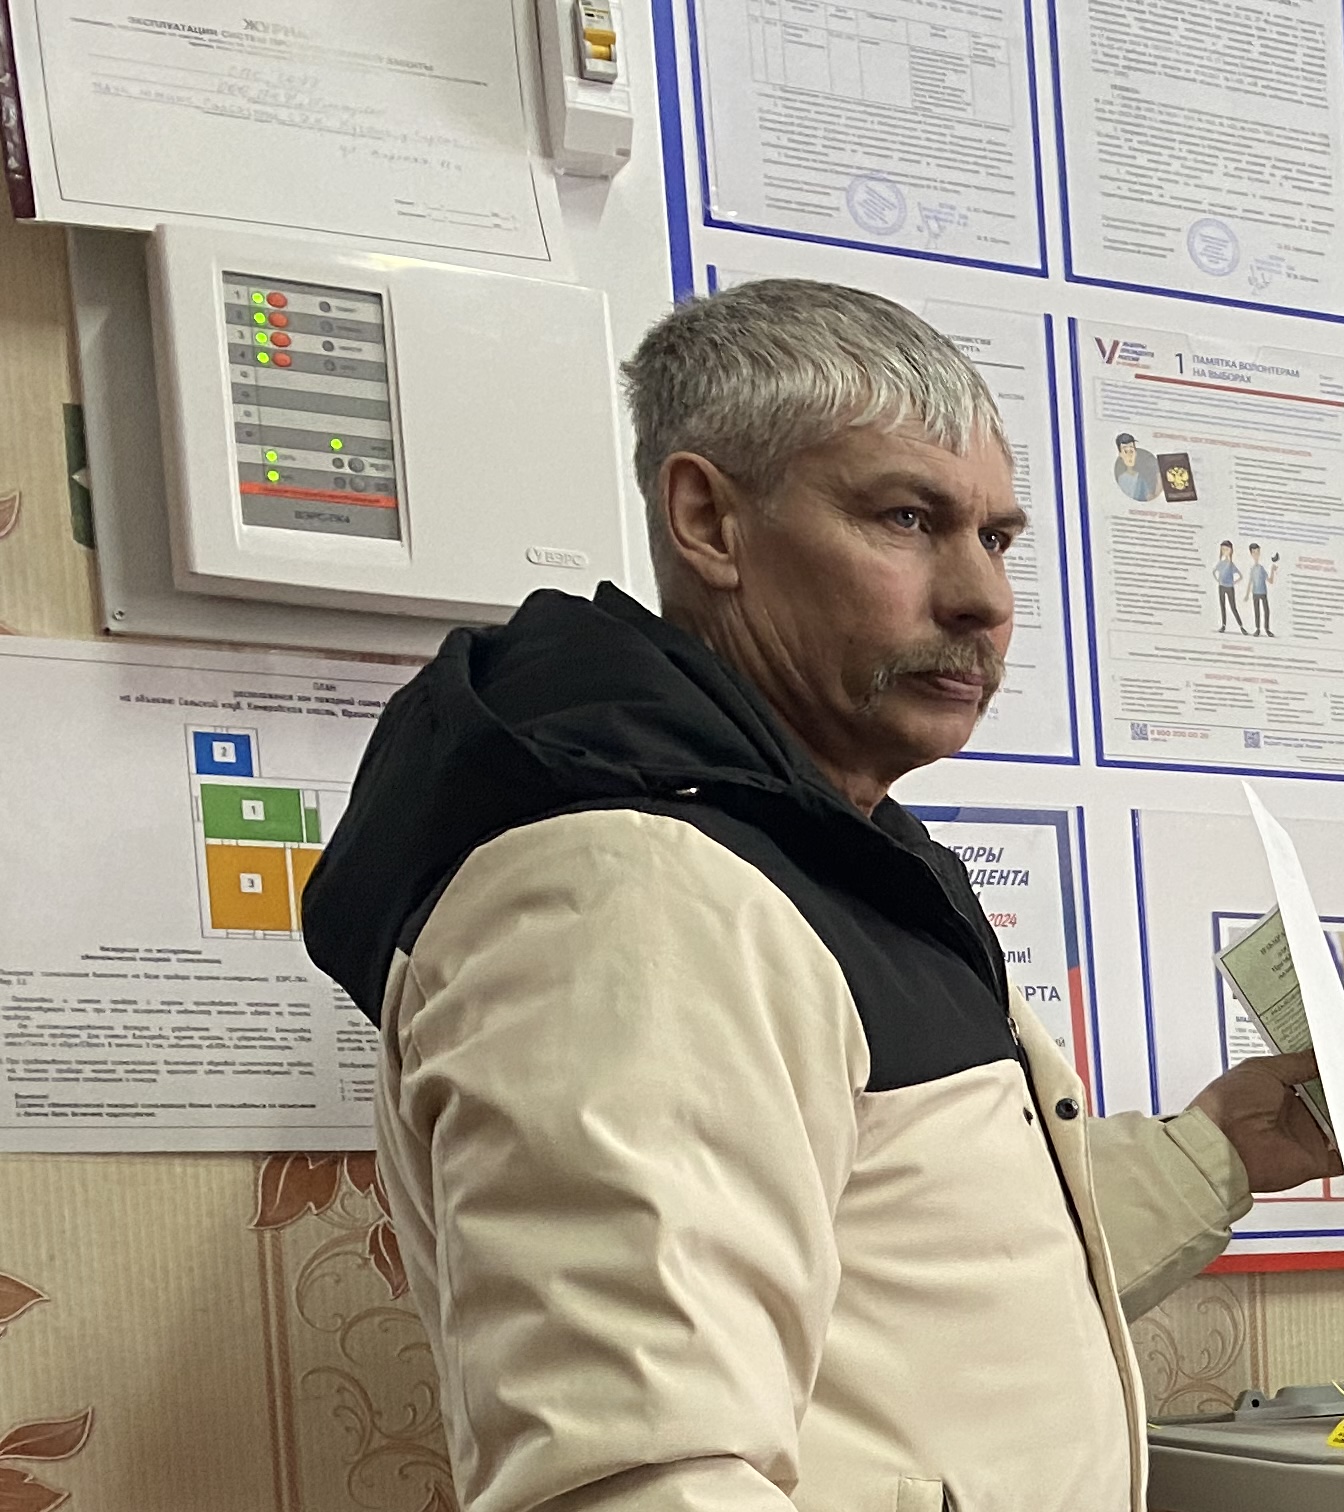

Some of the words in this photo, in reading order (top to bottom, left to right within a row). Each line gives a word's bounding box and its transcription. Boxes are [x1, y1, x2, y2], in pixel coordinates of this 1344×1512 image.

[1175, 352, 1184, 375] 1
[1192, 355, 1237, 370] ПАМЯТКА
[1239, 361, 1300, 378] ВОЛОНТЕРАМ
[1192, 368, 1206, 379] НА
[1208, 370, 1252, 384] ВЫБОРАХ
[1017, 985, 1061, 1002] РТА
